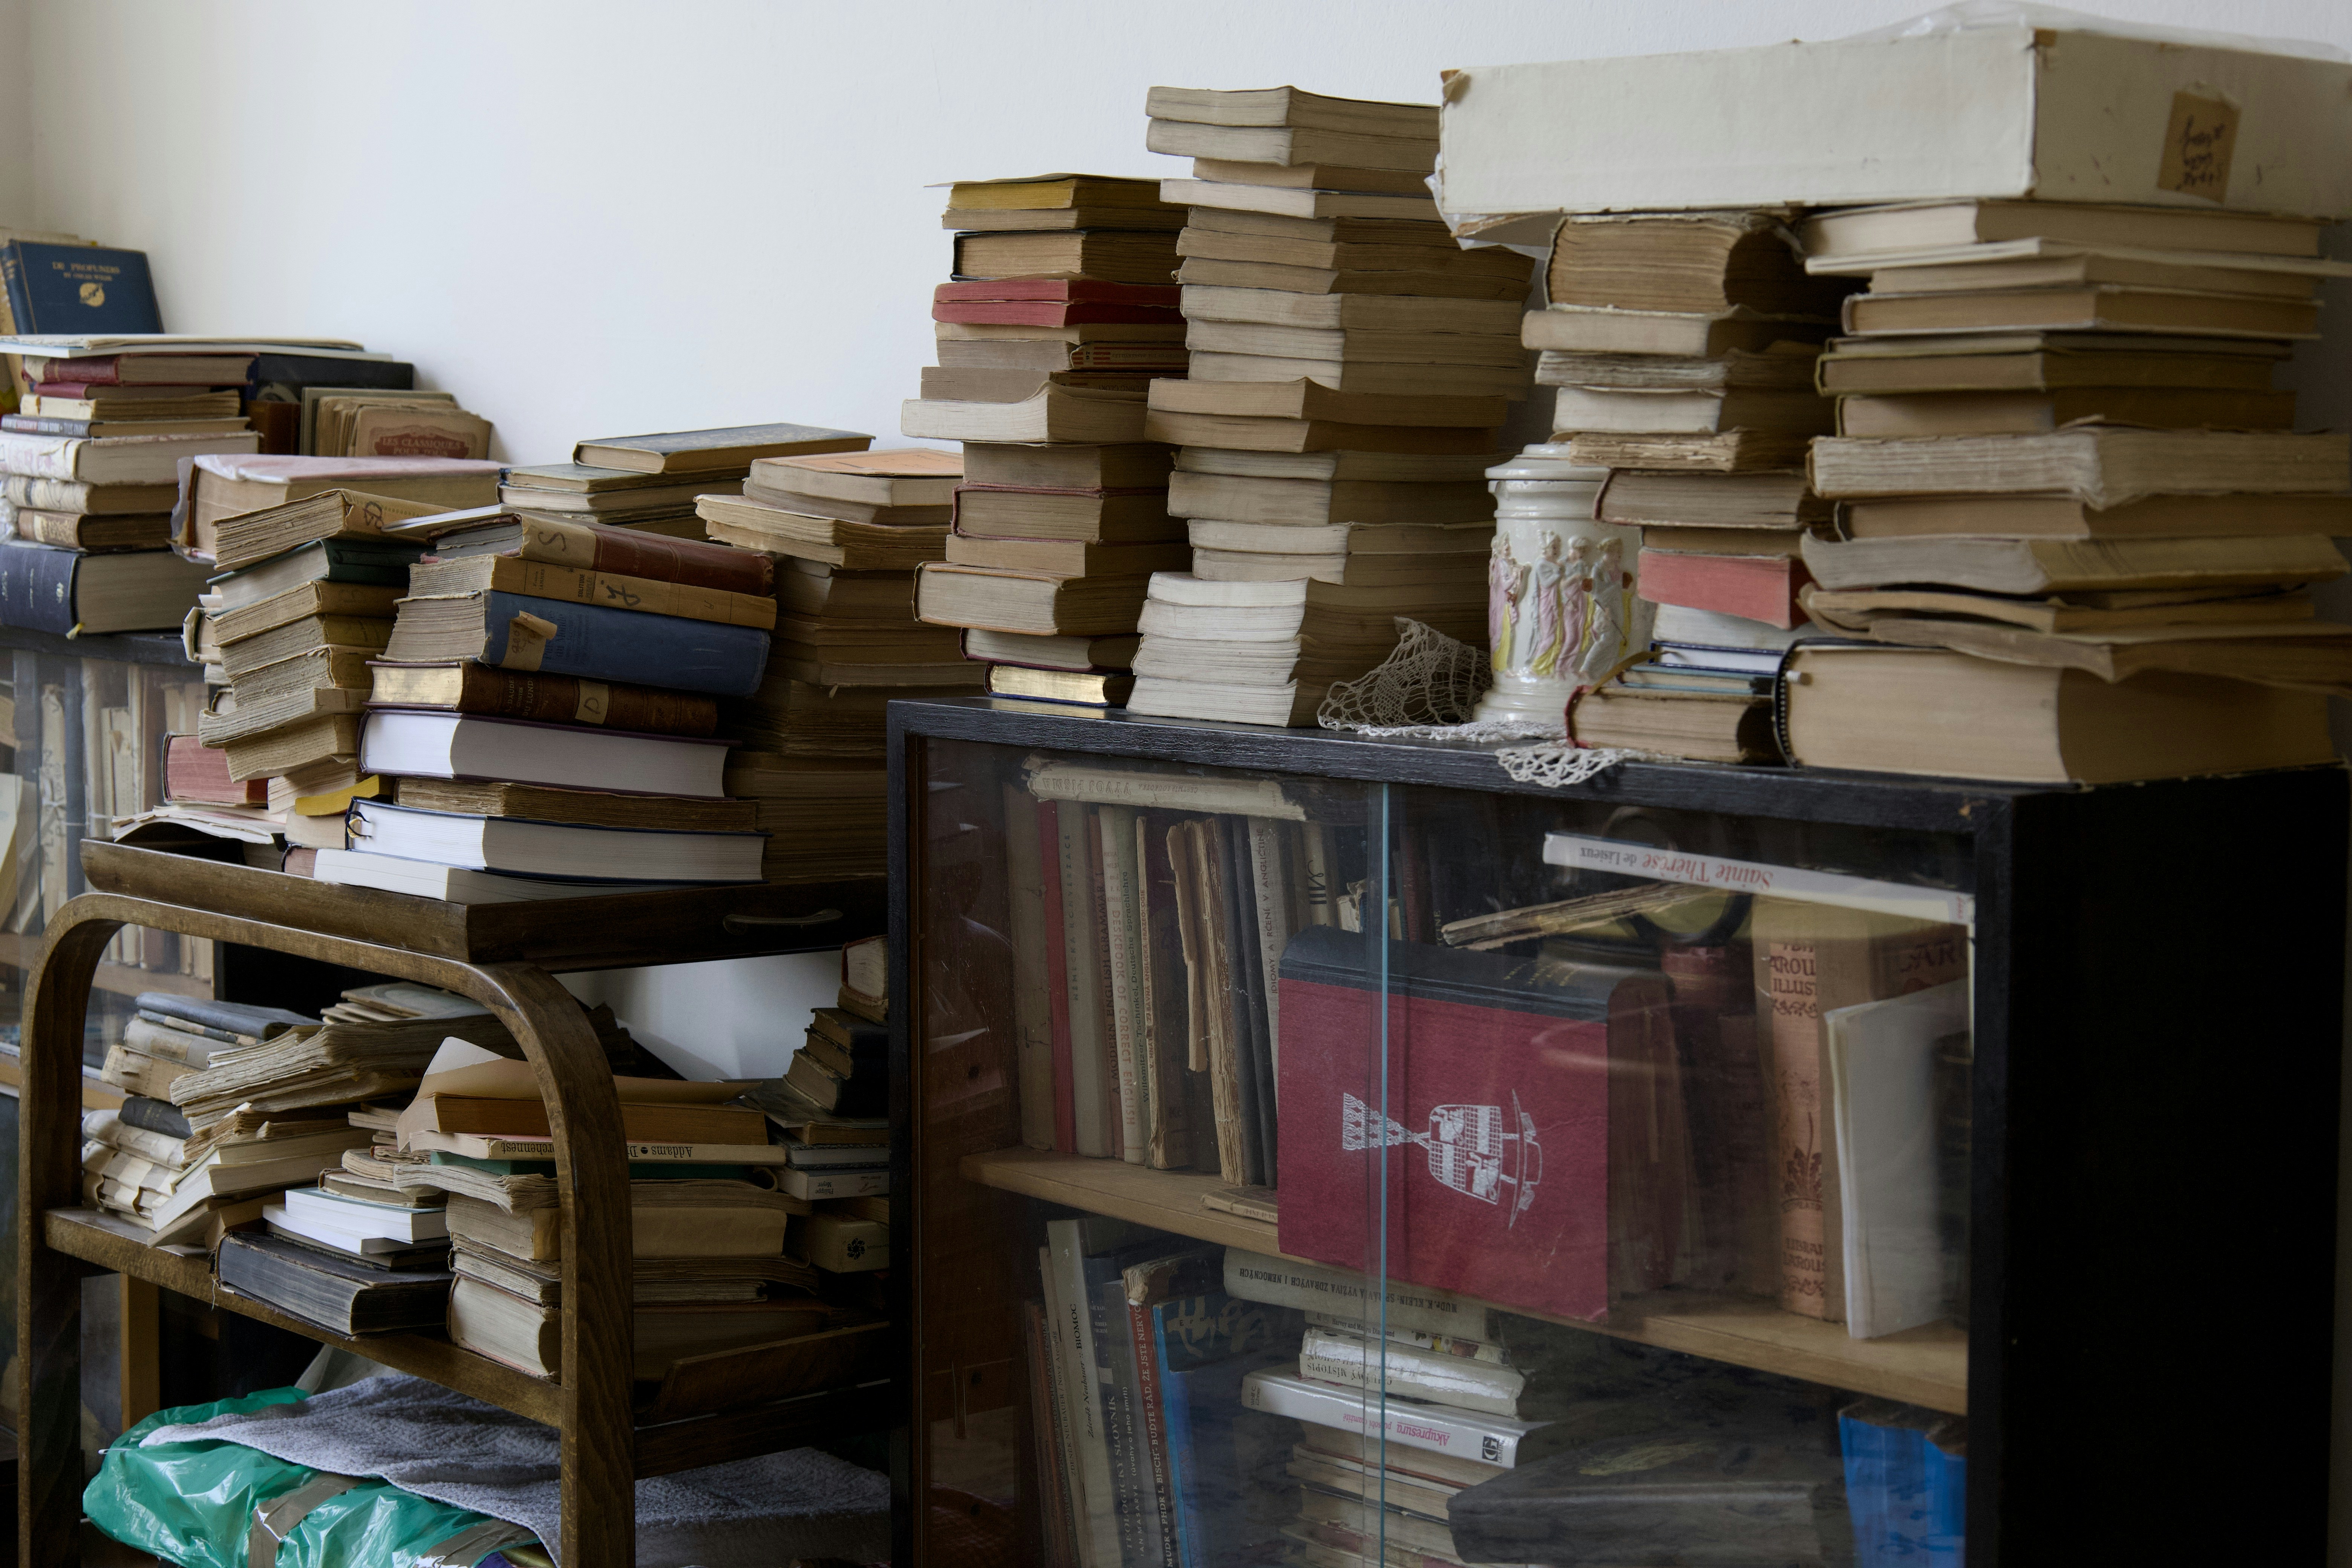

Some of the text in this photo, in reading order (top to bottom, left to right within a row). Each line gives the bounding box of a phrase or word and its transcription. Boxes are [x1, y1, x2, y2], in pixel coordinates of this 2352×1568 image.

[383, 437, 461, 449] LES CLASSIQUES
[522, 704, 530, 717] DU
[583, 697, 600, 714] D
[1042, 778, 1131, 798] VÝVOJ PÍSMA
[1578, 847, 1774, 891] Sainte Thérèse de Lisieux
[1122, 871, 1133, 932] Sprachlehre
[1096, 885, 1110, 953] GRAMMAR
[1128, 937, 1137, 983] Deutsche
[1101, 960, 1115, 1018] ENGLISH
[1268, 958, 1277, 994] IDIOMY
[1112, 910, 1136, 1125] DESKBOOK OF CORRECT ENGLISH
[1107, 1024, 1118, 1080] MODERN
[652, 1146, 694, 1158] Addams
[1239, 1268, 1282, 1283] NEMOCNÝCH
[1284, 1275, 1288, 1285] I
[1291, 1277, 1328, 1292] ZDRAVÝCH
[1331, 1283, 1357, 1297] VÝŽIVA
[1397, 1294, 1424, 1307] KLEIN:
[1070, 1304, 1082, 1350] BIOMOC
[1332, 1318, 1347, 1328] Harvey
[1372, 1326, 1395, 1337] Diaond
[1139, 1343, 1148, 1367] JSTE
[1081, 1359, 1089, 1403] Neubauer
[1141, 1369, 1150, 1381] ŽE
[1307, 1362, 1347, 1378] MÍSTOPIS
[1144, 1384, 1154, 1409] RÁD,
[1060, 1394, 1069, 1439] NEUBAUER
[1084, 1406, 1094, 1438] Zdeněk
[1107, 1395, 1121, 1456] SLOVNÍK
[1396, 1423, 1450, 1446] Akupresura
[1065, 1442, 1076, 1476] ZDENĚK
[1133, 1485, 1142, 1534] MASARYK
[1159, 1496, 1168, 1525] PHDR
[1164, 1536, 1173, 1568] MUDR
